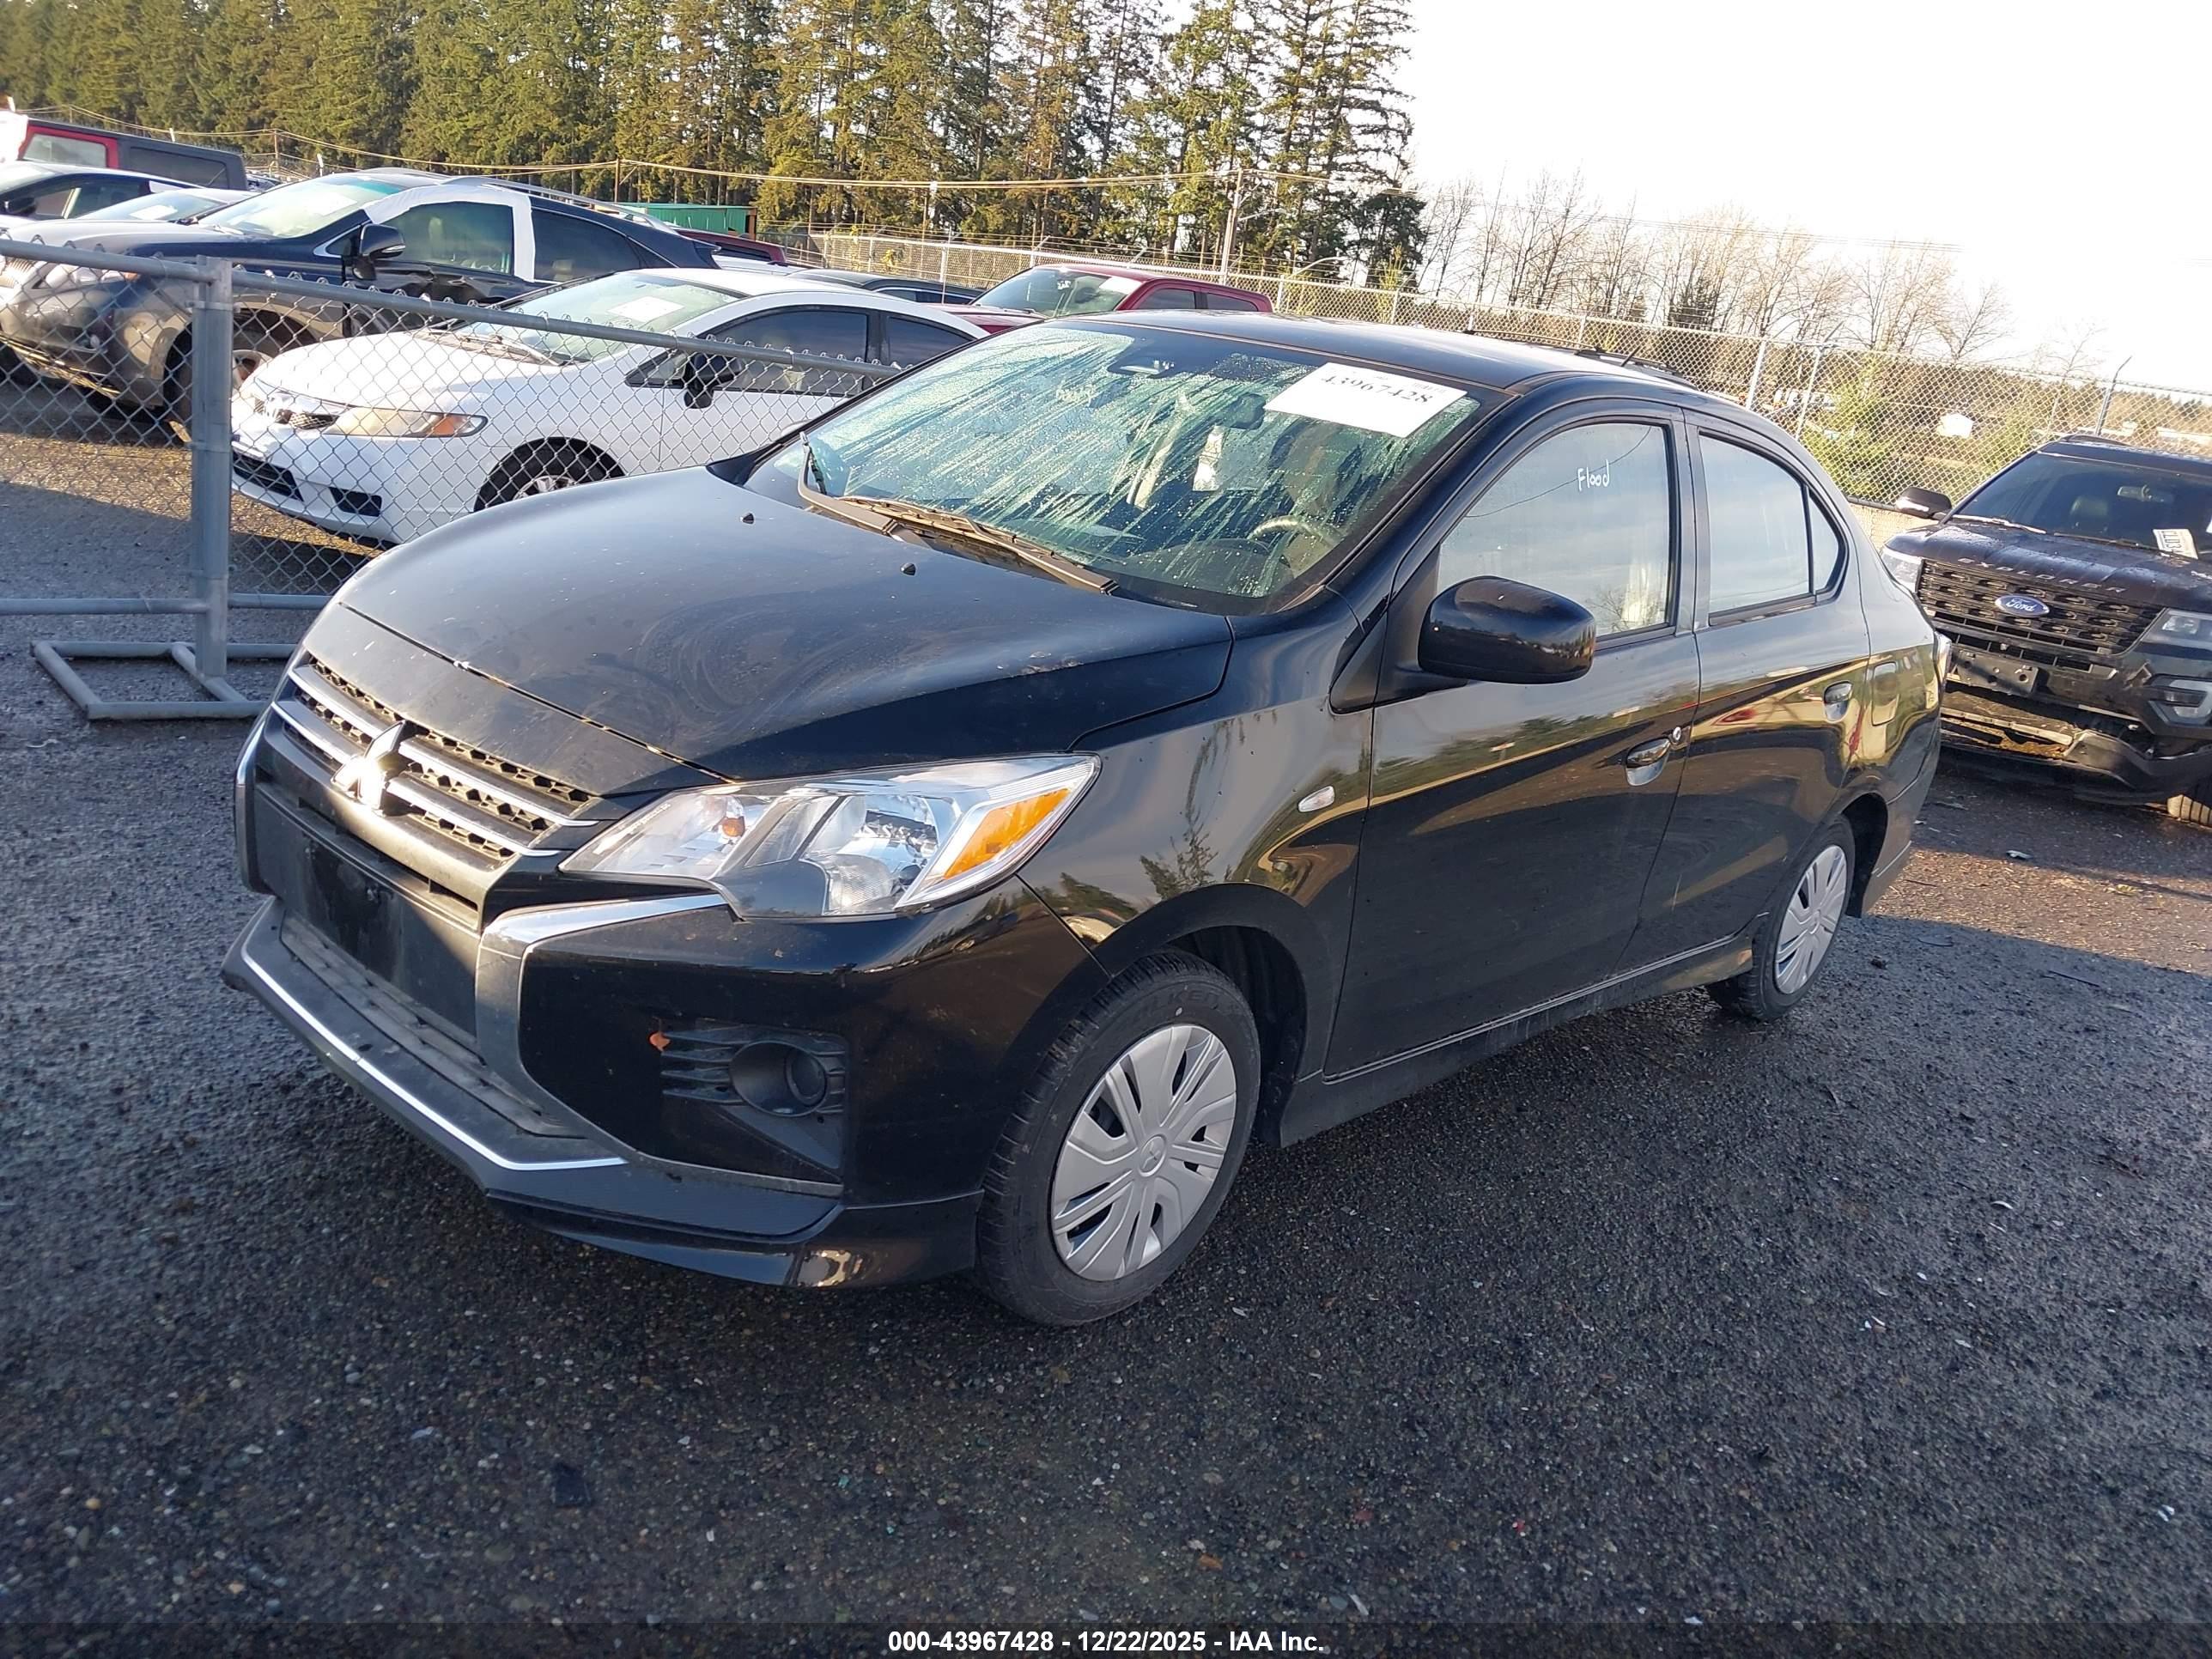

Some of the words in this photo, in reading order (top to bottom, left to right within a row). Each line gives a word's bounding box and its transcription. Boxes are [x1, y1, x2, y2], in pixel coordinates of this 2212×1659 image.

[1321, 374, 1434, 404] 43967428
[1577, 459, 1610, 492] Flood
[1956, 556, 2128, 593] EXPLORER
